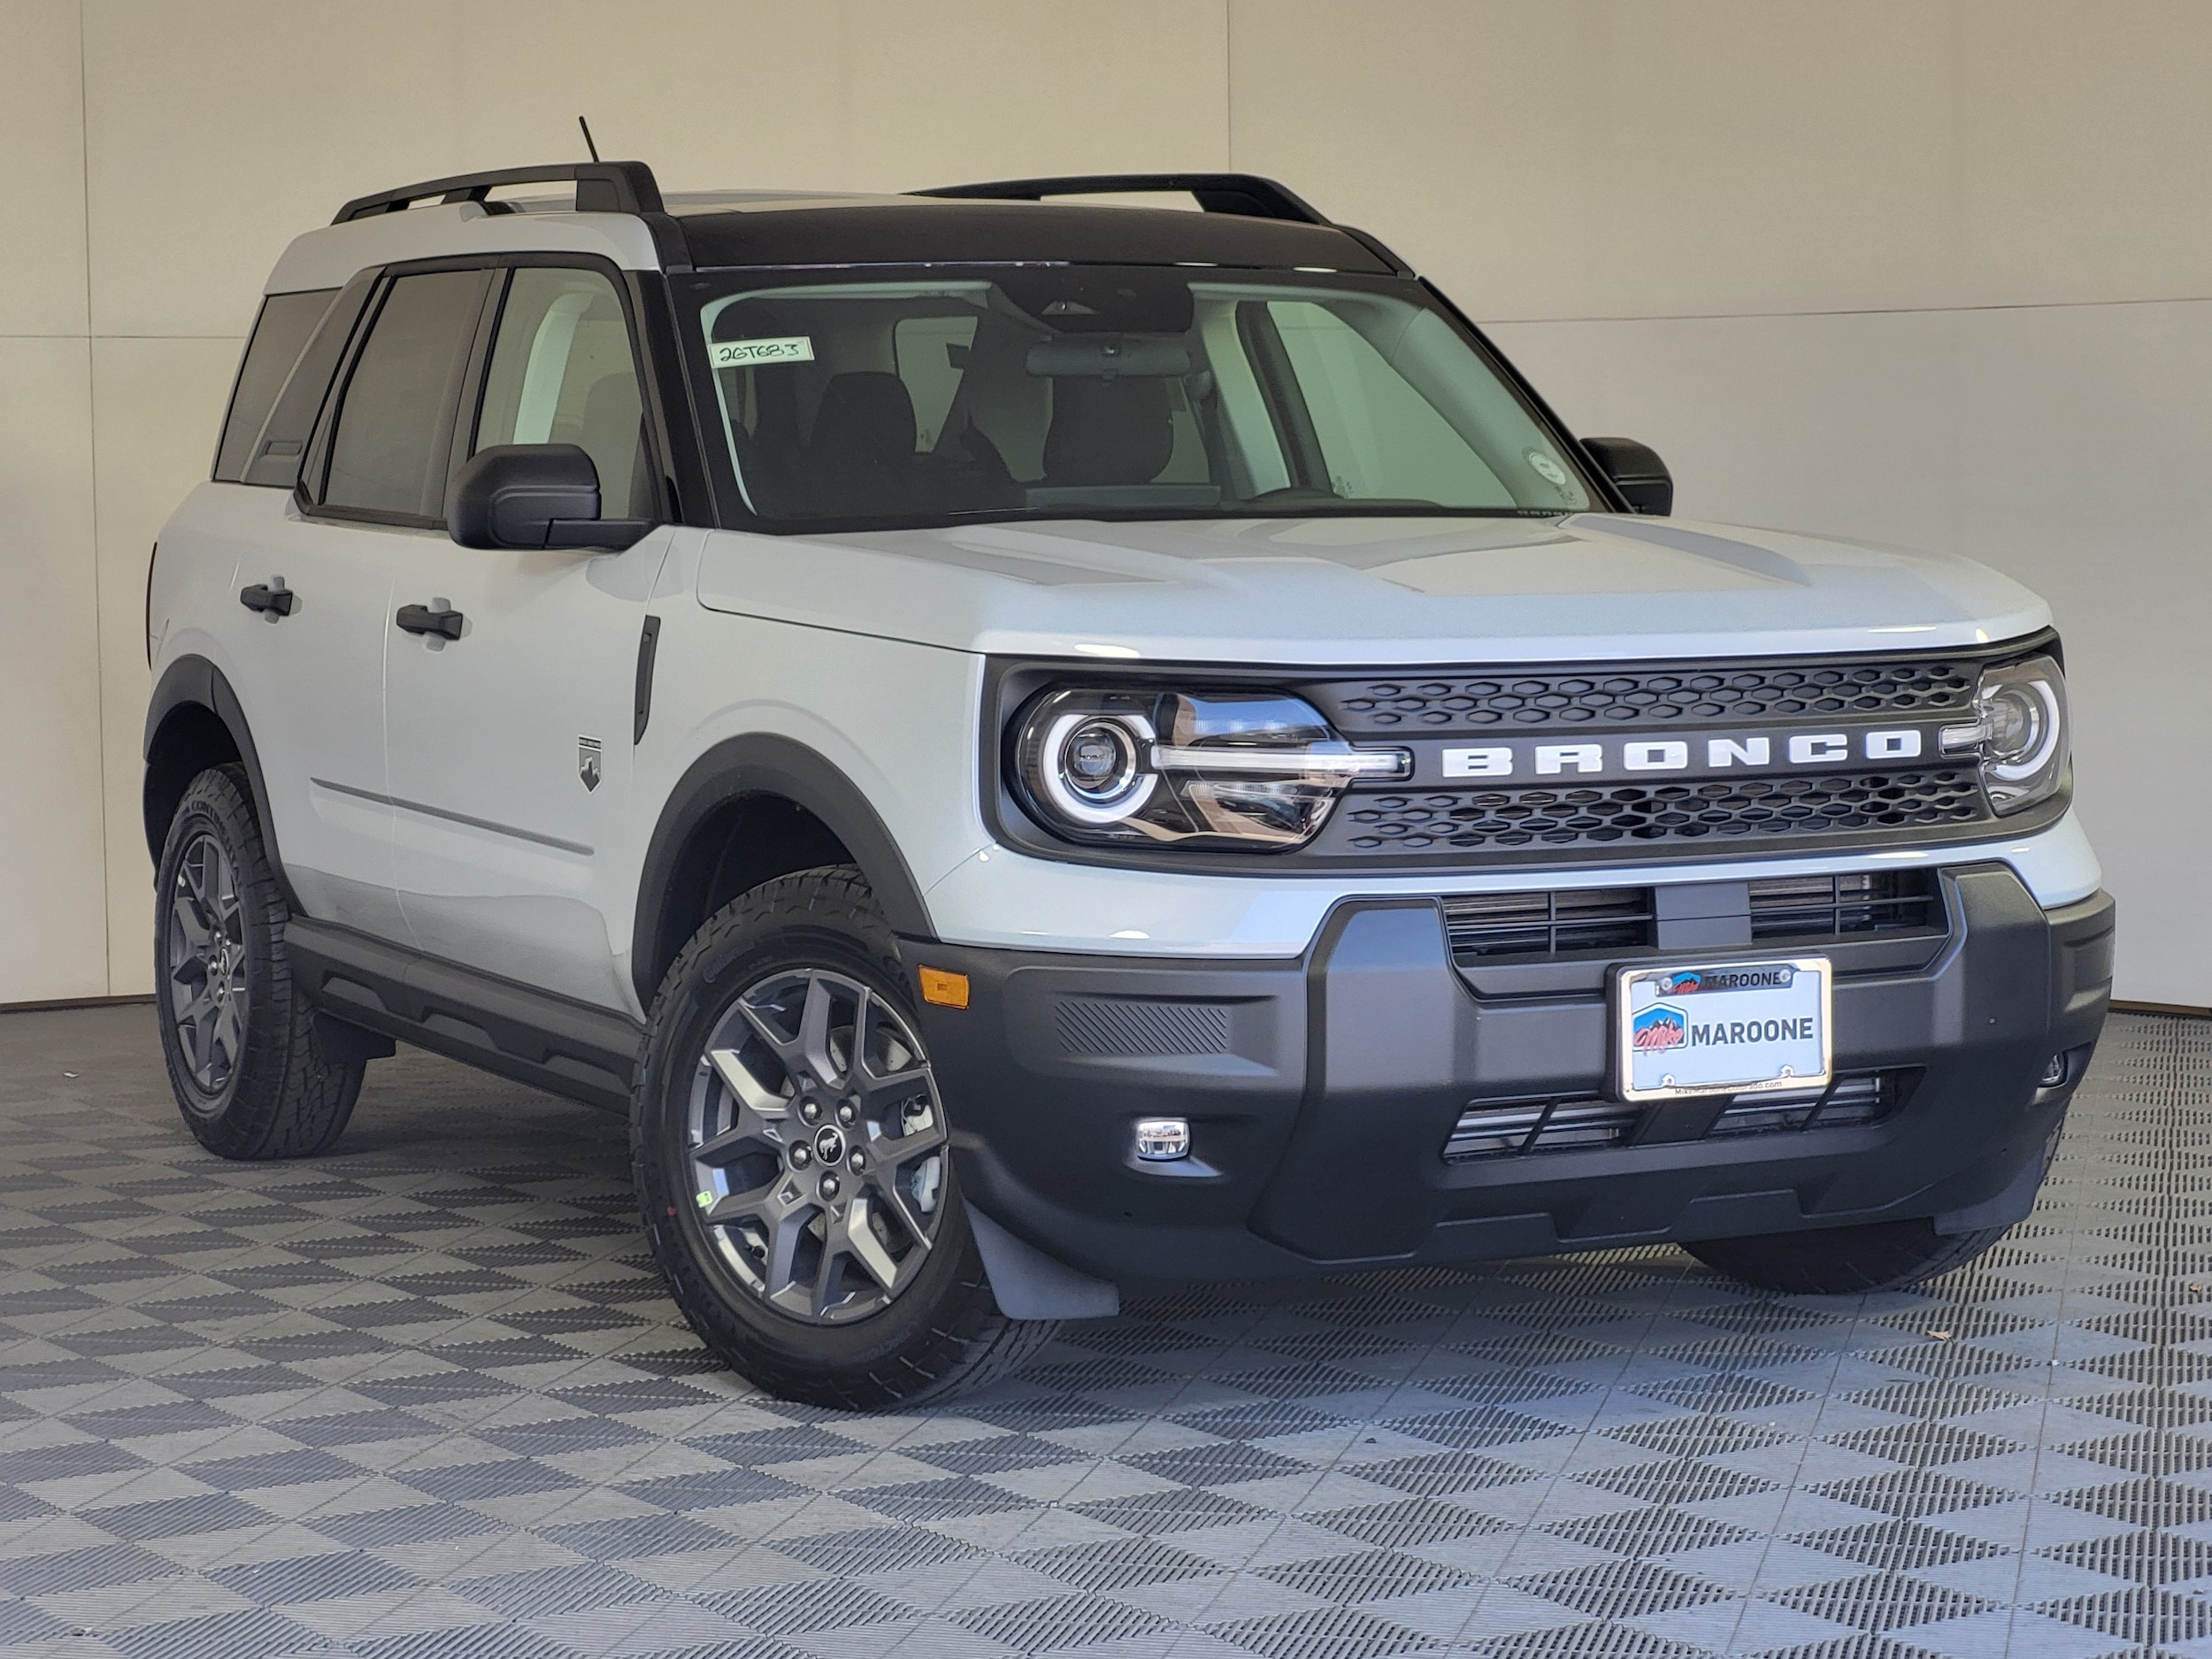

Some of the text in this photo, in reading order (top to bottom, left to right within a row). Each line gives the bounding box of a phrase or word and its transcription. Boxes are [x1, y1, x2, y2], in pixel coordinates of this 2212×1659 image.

[1441, 730, 1922, 777] BRONCO
[1704, 972, 1782, 989] MAROONE
[1634, 1018, 1813, 1056] Mike MAROONE
